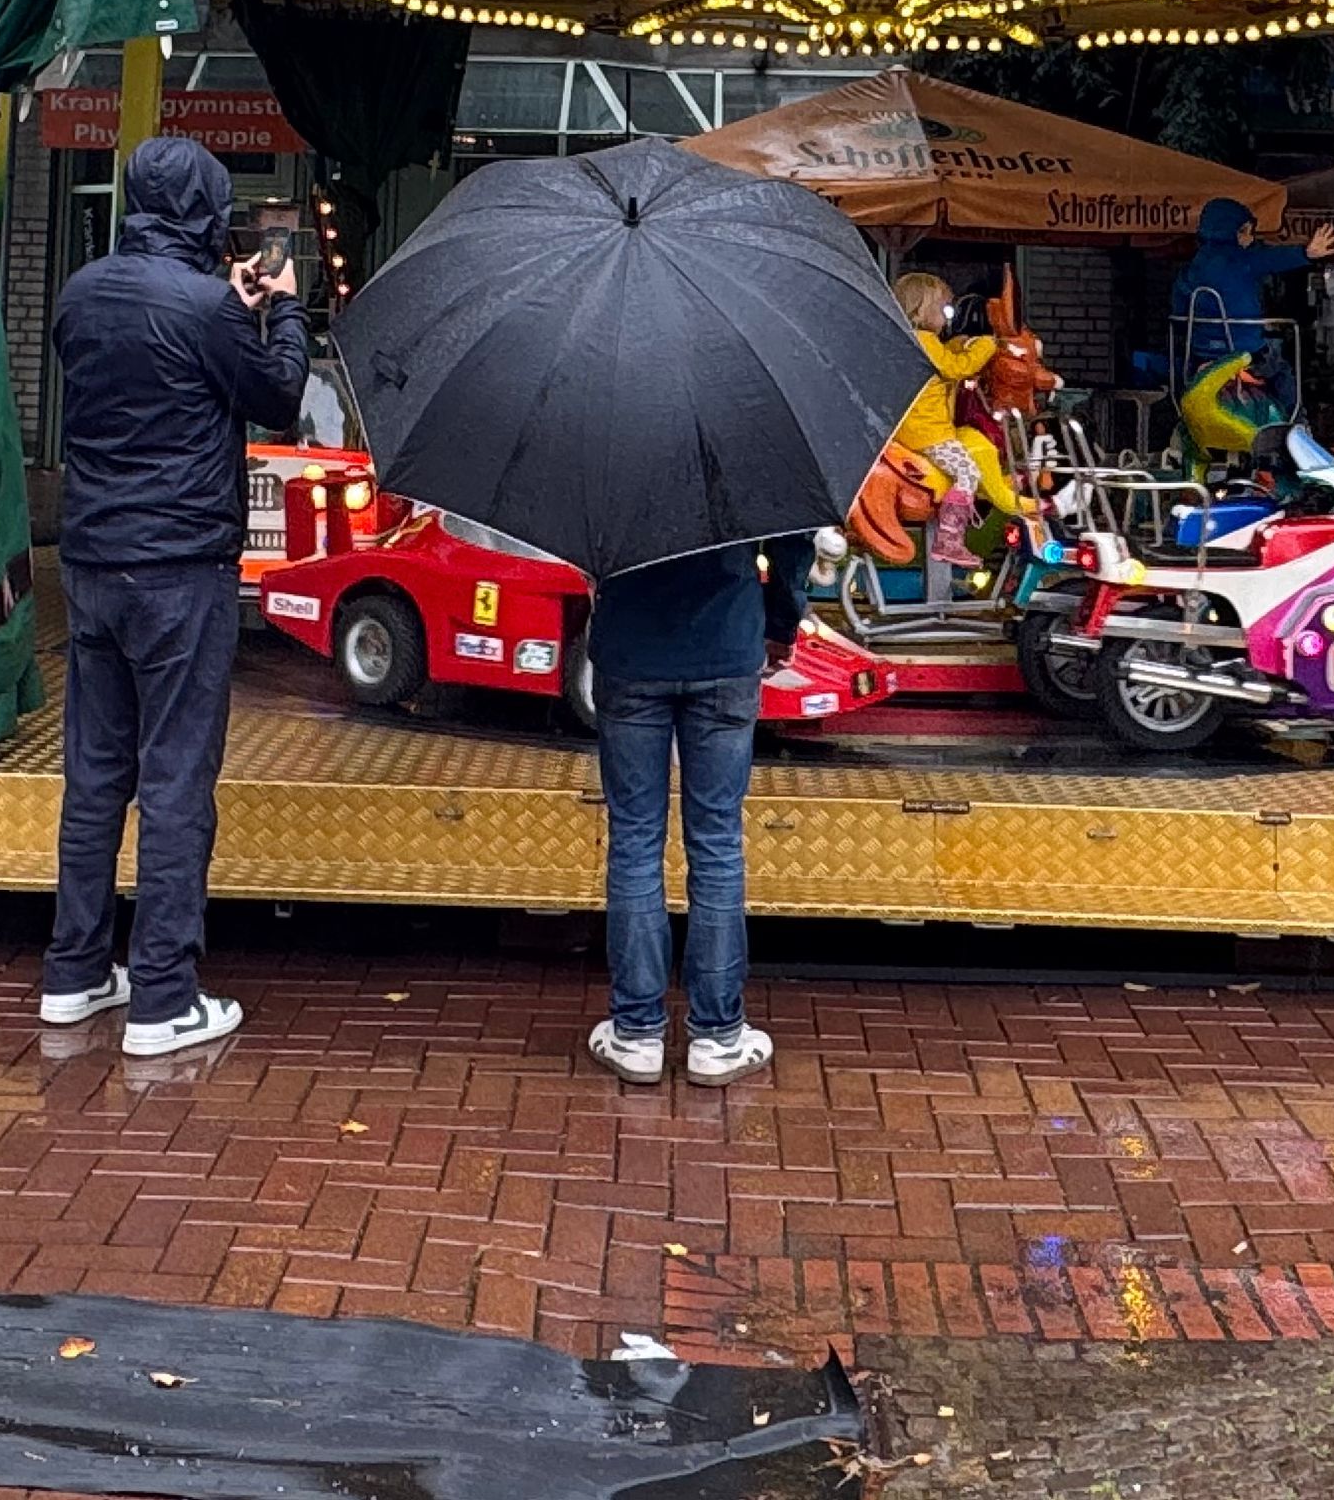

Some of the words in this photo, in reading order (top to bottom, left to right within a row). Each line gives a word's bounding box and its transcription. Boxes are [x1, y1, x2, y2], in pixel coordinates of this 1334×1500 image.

[796, 140, 1074, 175] Schöfferhofer
[1046, 188, 1192, 230] Schöfferhofer
[273, 598, 314, 615] Shell
